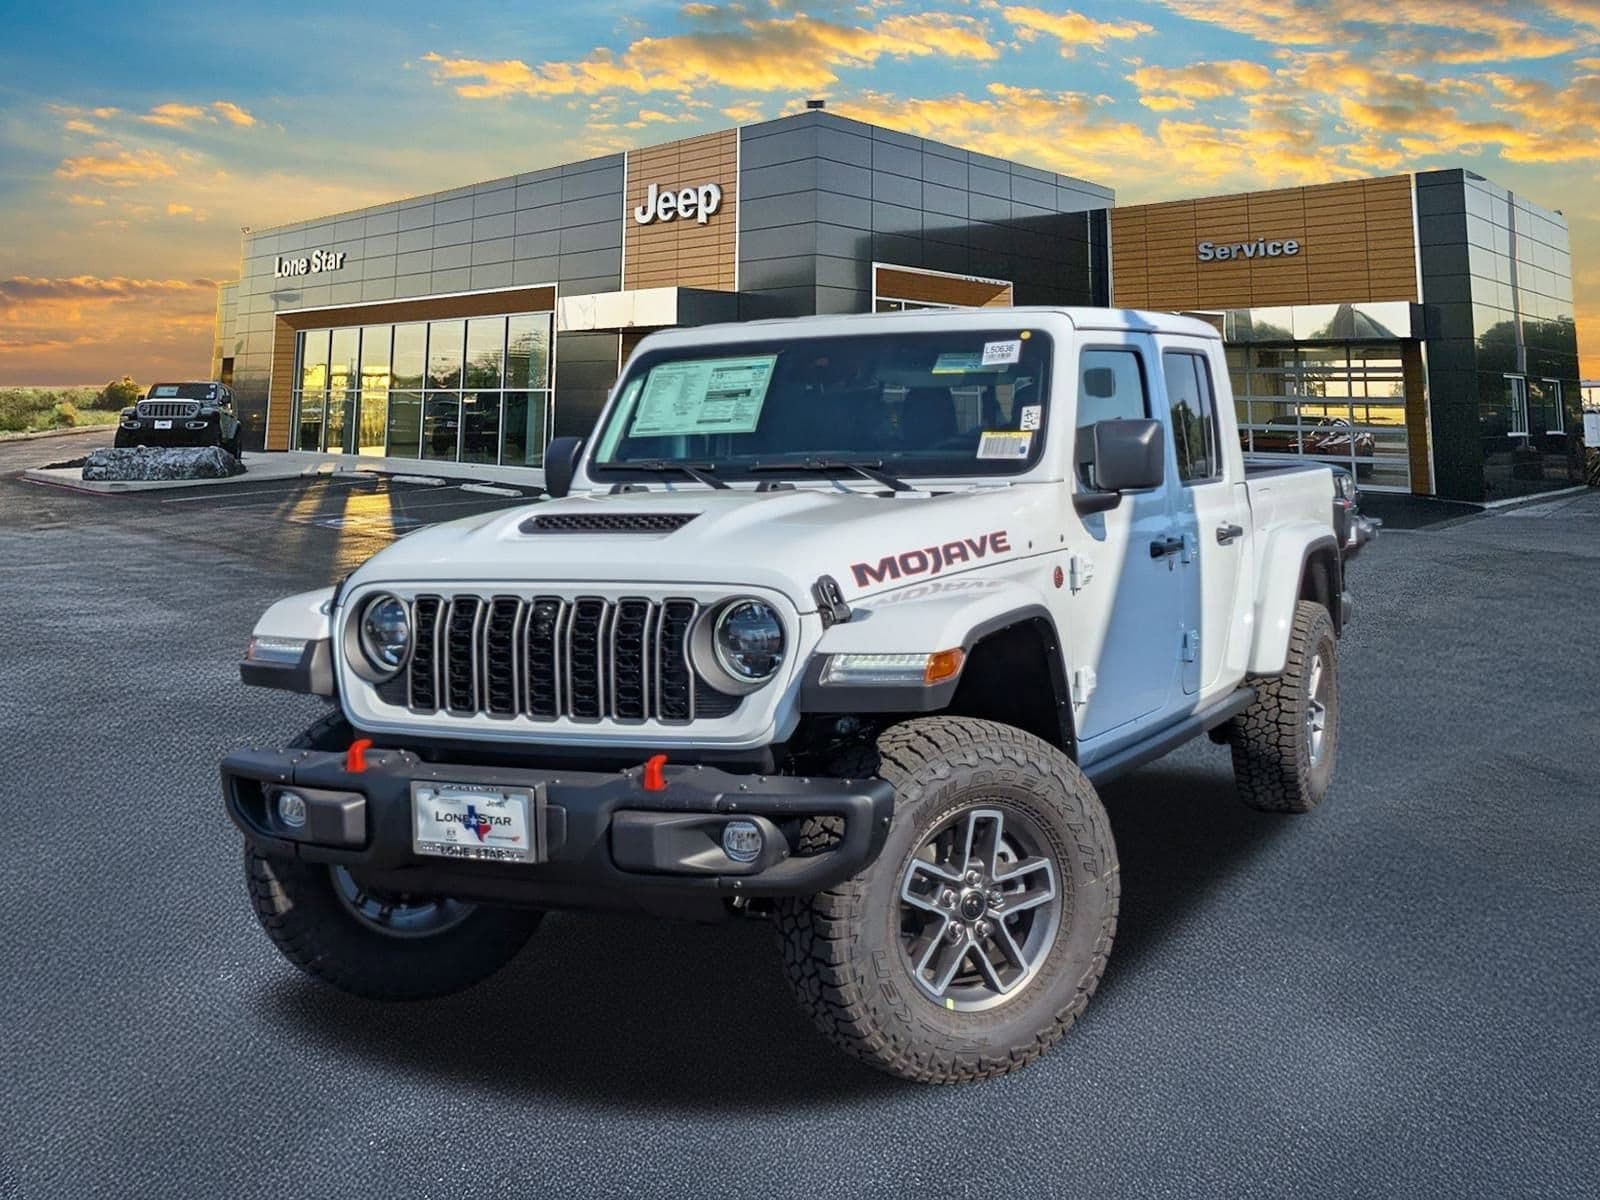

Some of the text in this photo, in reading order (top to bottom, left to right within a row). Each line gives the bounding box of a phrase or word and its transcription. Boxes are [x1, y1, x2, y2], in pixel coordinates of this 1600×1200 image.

[634, 183, 722, 224] Jeep
[275, 249, 346, 278] Lone Star
[1198, 237, 1299, 261] Service
[850, 530, 1011, 588] MOJAVE
[435, 811, 512, 826] LONE STAR
